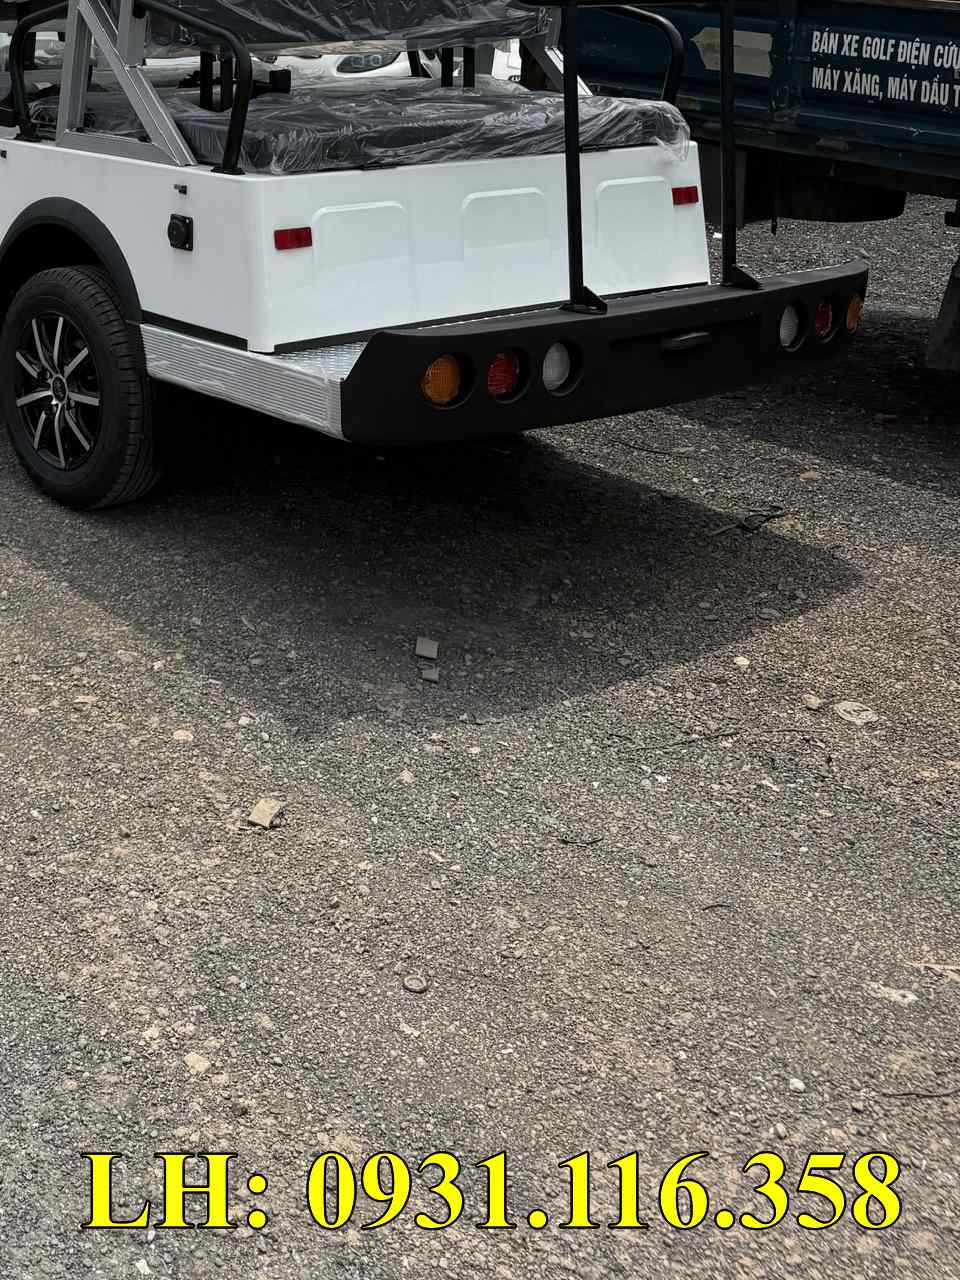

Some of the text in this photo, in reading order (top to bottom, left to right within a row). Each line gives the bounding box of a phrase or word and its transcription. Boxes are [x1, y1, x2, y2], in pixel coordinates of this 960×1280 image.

[811, 27, 839, 55] BÁN
[841, 34, 860, 57] XE
[862, 36, 896, 61] GOLF
[897, 37, 931, 70] ĐIỆN
[811, 63, 840, 91] MÁY
[843, 67, 883, 100] XĂNG,
[887, 73, 917, 101] MÁY
